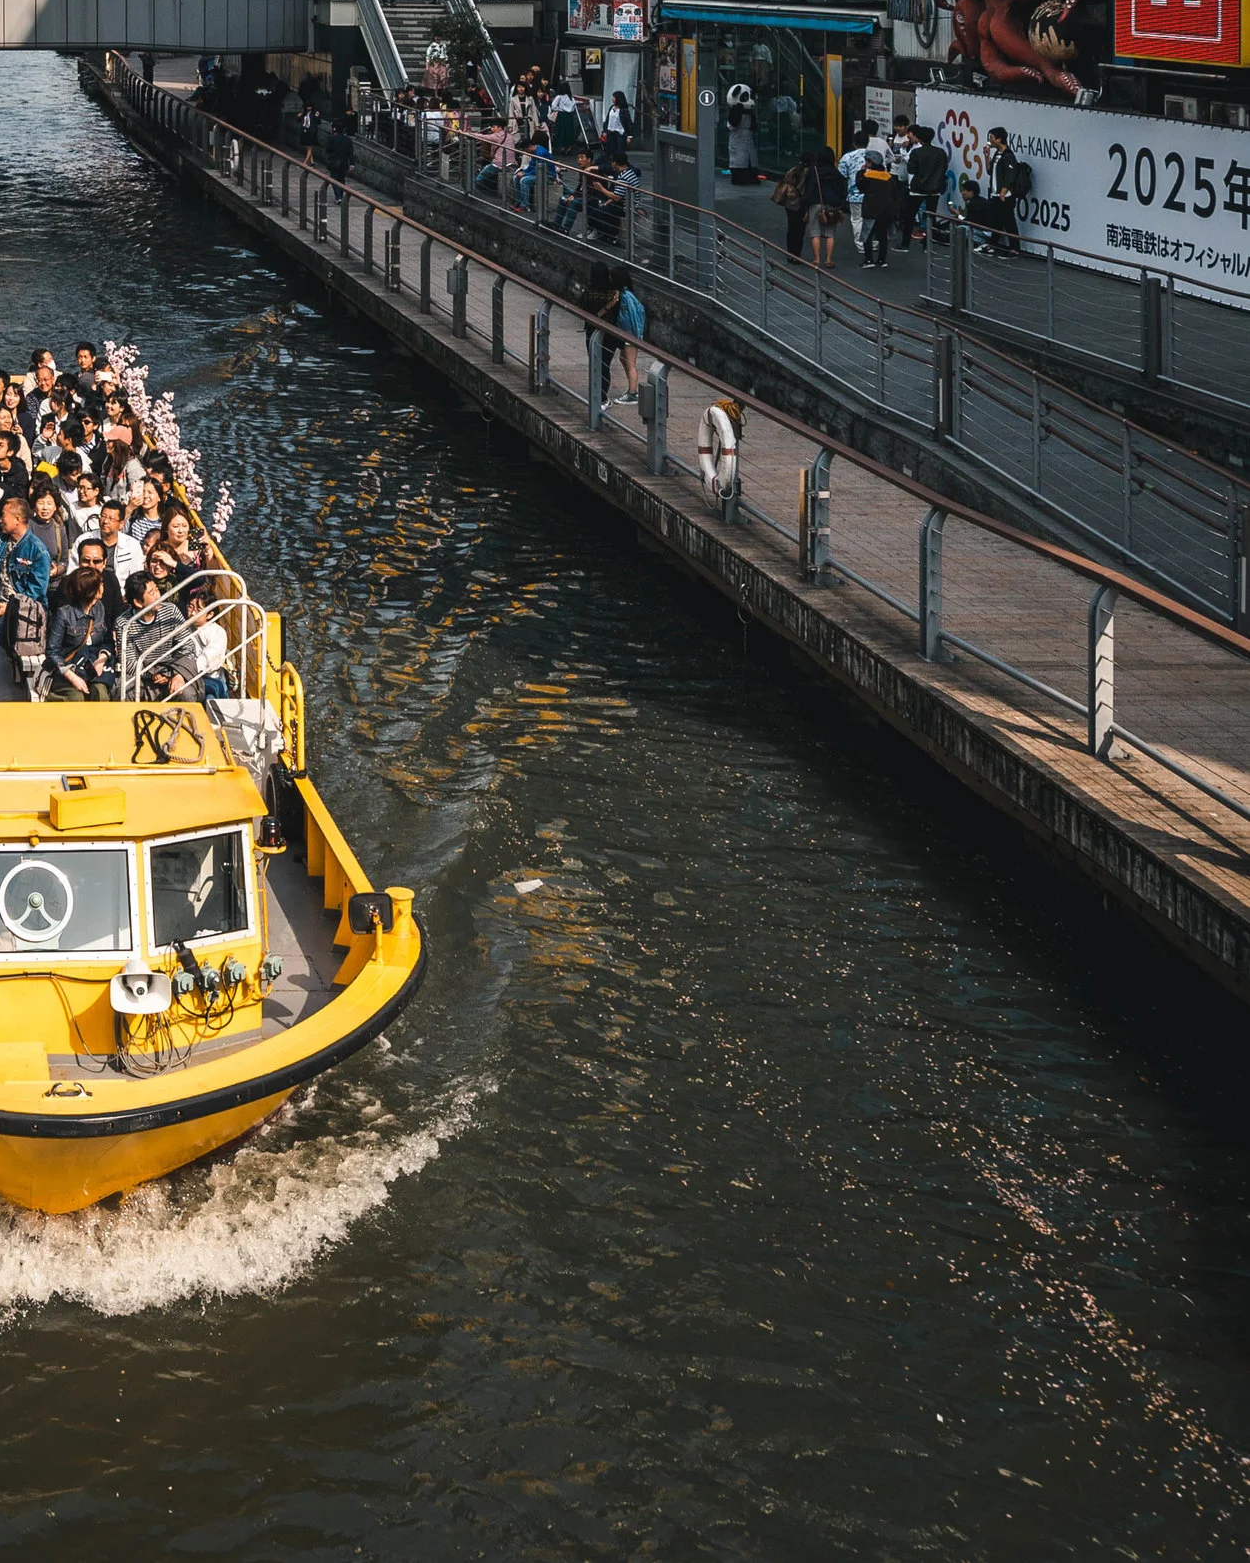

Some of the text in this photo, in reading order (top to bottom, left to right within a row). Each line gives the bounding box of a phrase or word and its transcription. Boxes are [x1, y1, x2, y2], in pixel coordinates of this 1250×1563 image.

[1009, 132, 1071, 163] KA-KANSAI
[1107, 142, 1250, 231] 2025年
[1031, 201, 1070, 232] 2025
